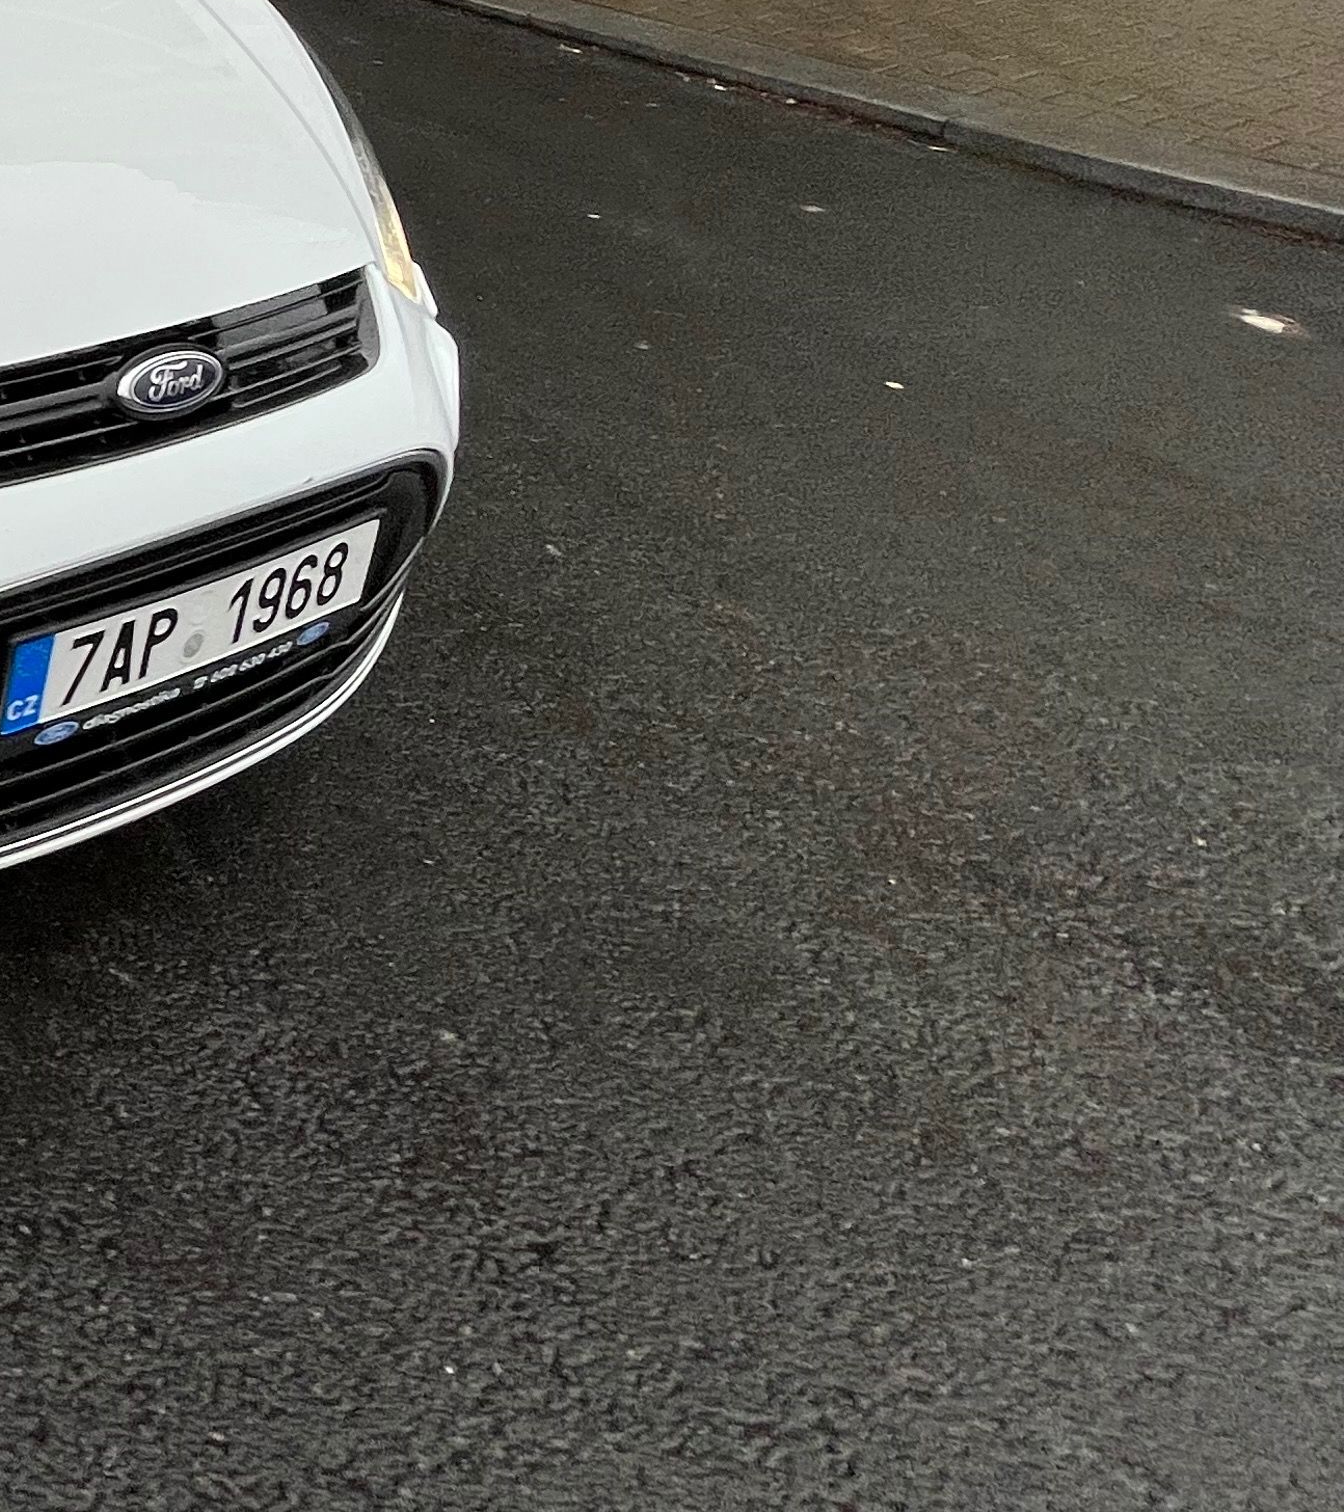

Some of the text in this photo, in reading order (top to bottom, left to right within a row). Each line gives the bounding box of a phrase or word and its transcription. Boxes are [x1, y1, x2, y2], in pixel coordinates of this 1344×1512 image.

[148, 360, 205, 402] Ford
[60, 542, 349, 707] 7AP 1968
[6, 694, 39, 721] CZ
